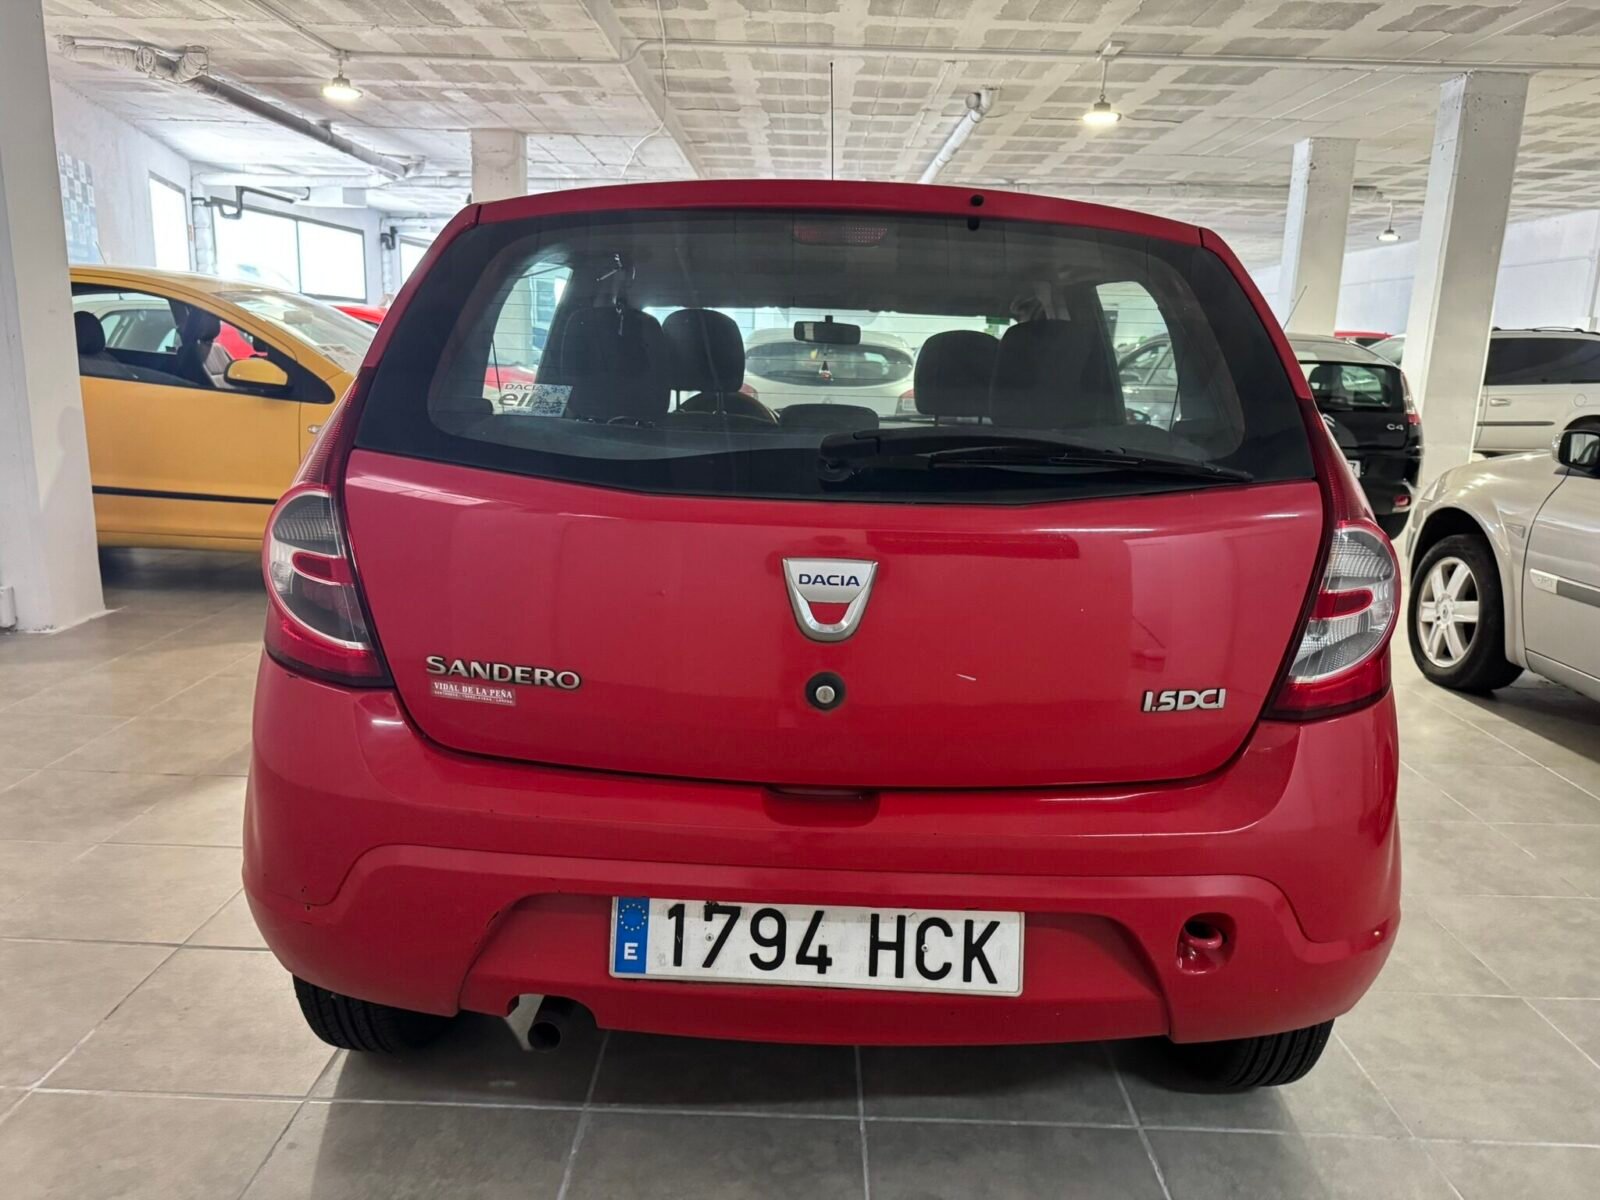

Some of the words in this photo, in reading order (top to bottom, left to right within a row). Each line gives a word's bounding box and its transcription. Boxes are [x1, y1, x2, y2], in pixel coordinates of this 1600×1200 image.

[504, 383, 544, 391] DACIA
[1387, 423, 1404, 431] C4
[799, 574, 860, 586] DACIA
[425, 655, 581, 690] SANDERO
[434, 682, 459, 692] VIDAL
[462, 685, 473, 694] DE
[476, 687, 487, 696] LA
[490, 688, 512, 699] PEÑA
[624, 942, 638, 960] E
[668, 902, 833, 974] 1794
[869, 913, 1000, 984] HCK
